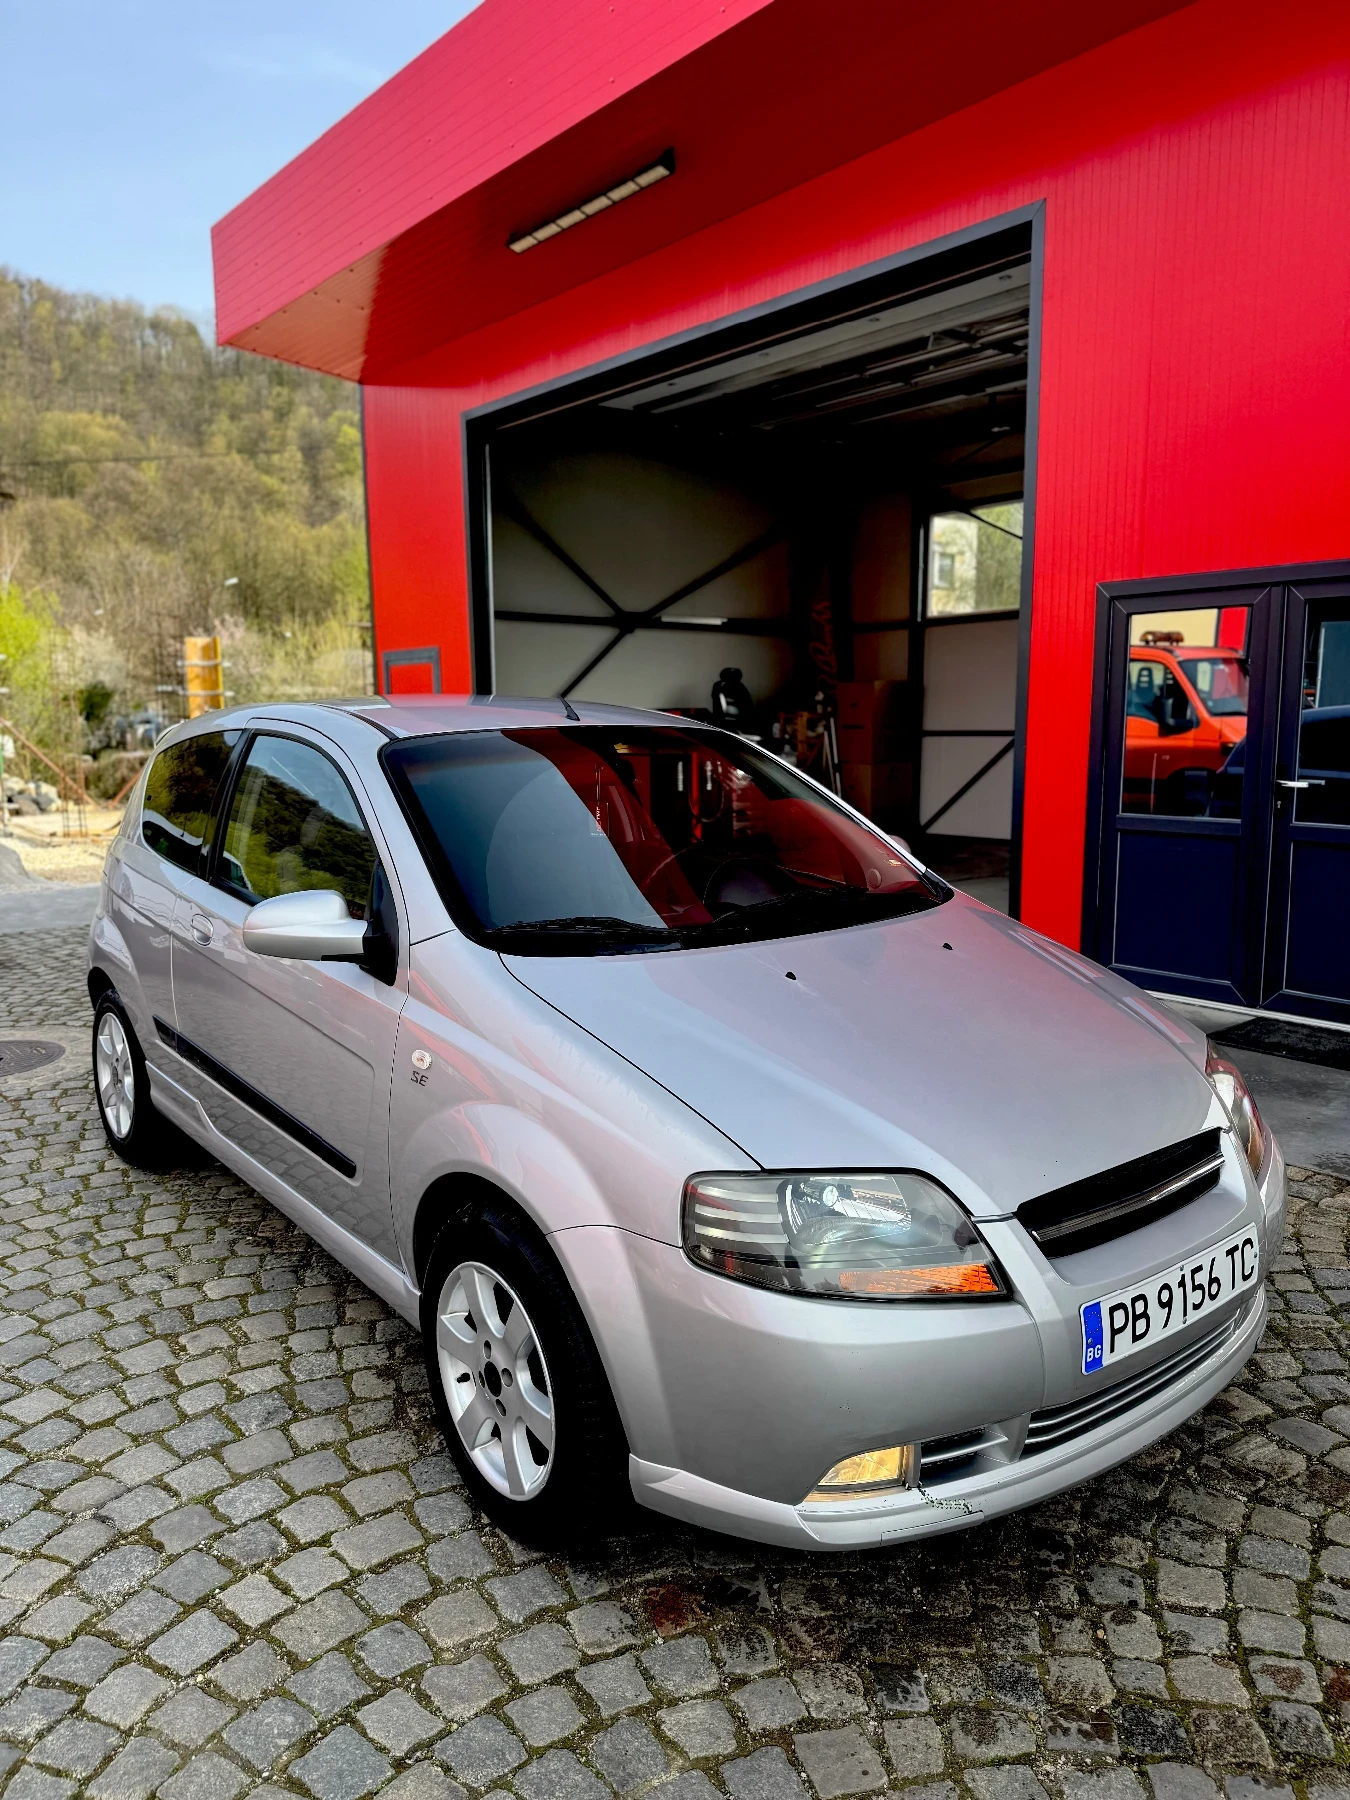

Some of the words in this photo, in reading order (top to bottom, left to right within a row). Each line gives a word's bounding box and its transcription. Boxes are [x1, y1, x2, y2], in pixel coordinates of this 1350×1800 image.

[410, 1070, 429, 1087] SE
[1108, 1293, 1150, 1354] PB
[1157, 1256, 1222, 1330] 9156
[1225, 1237, 1255, 1291] TC
[1086, 1344, 1102, 1363] BG
